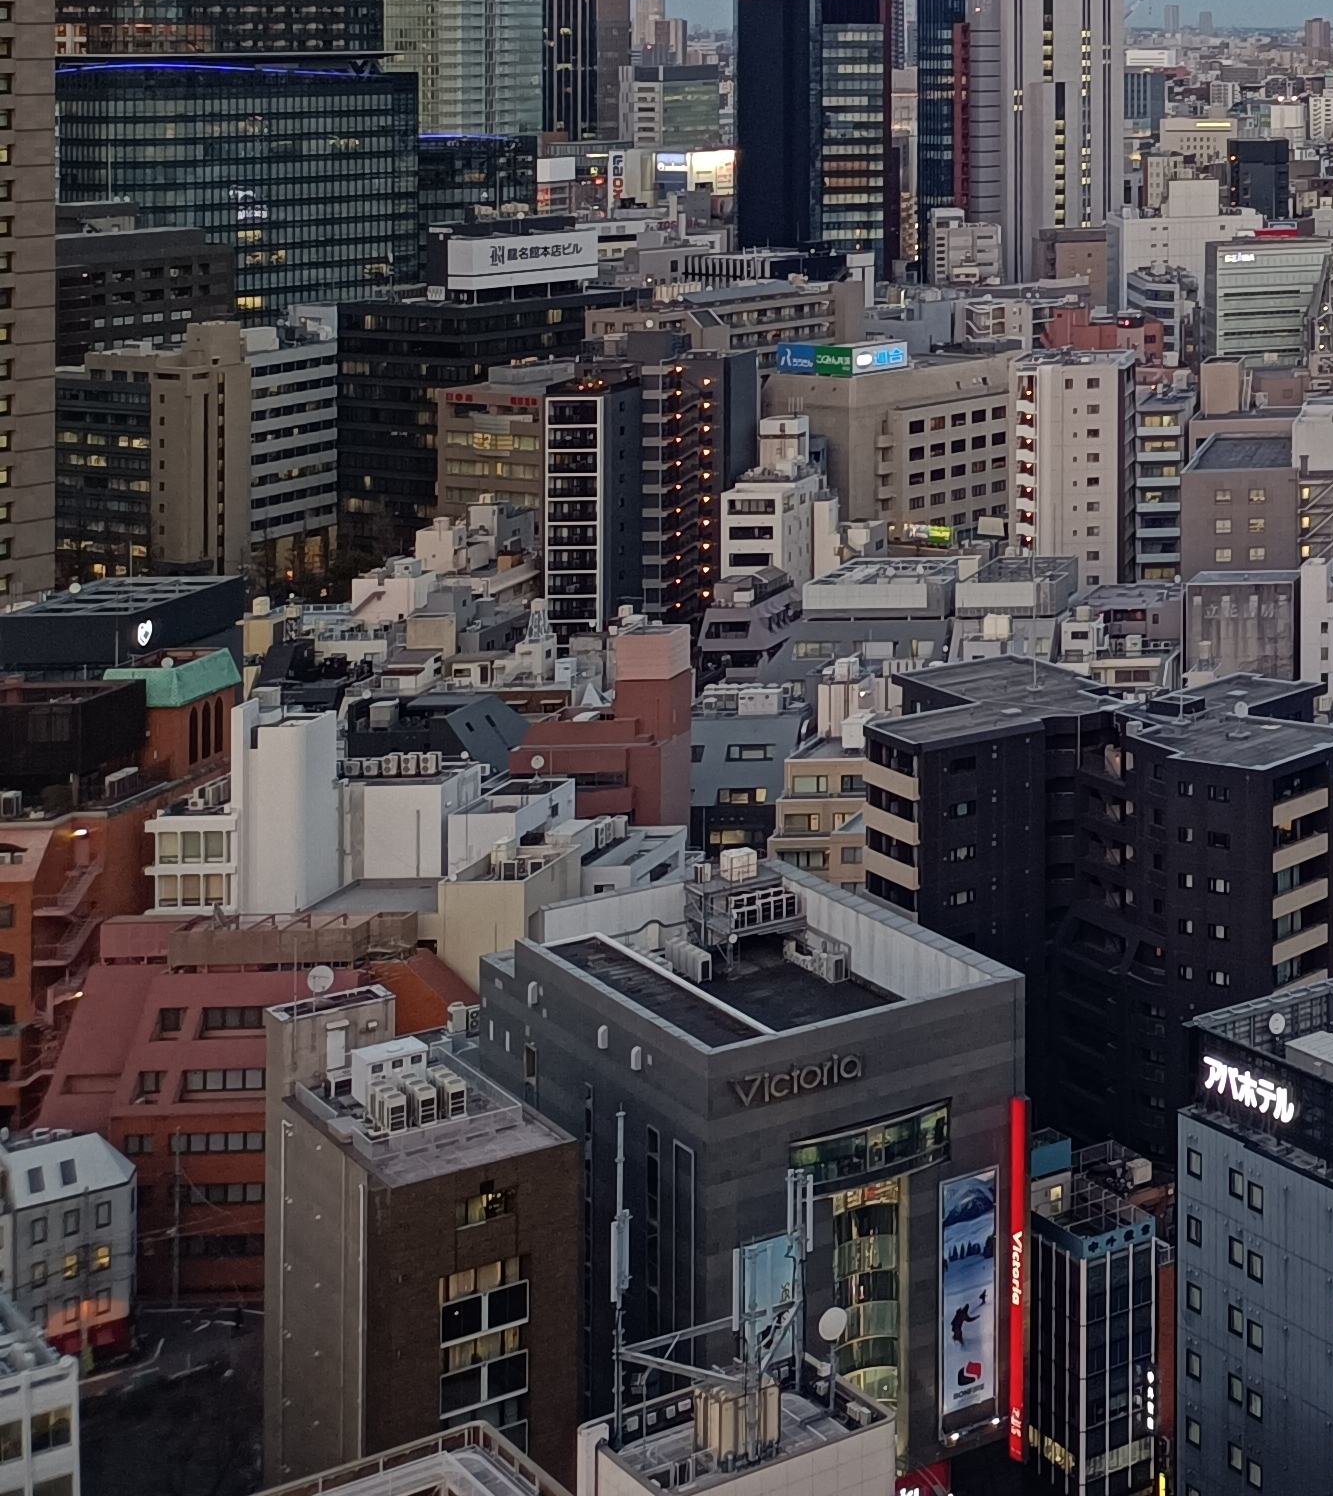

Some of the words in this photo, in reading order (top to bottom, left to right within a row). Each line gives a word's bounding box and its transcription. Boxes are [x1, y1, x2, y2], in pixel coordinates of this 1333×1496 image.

[727, 1053, 862, 1107] Victoria
[1203, 1055, 1295, 1123] アパホテル
[1011, 1231, 1024, 1305] Victoria
